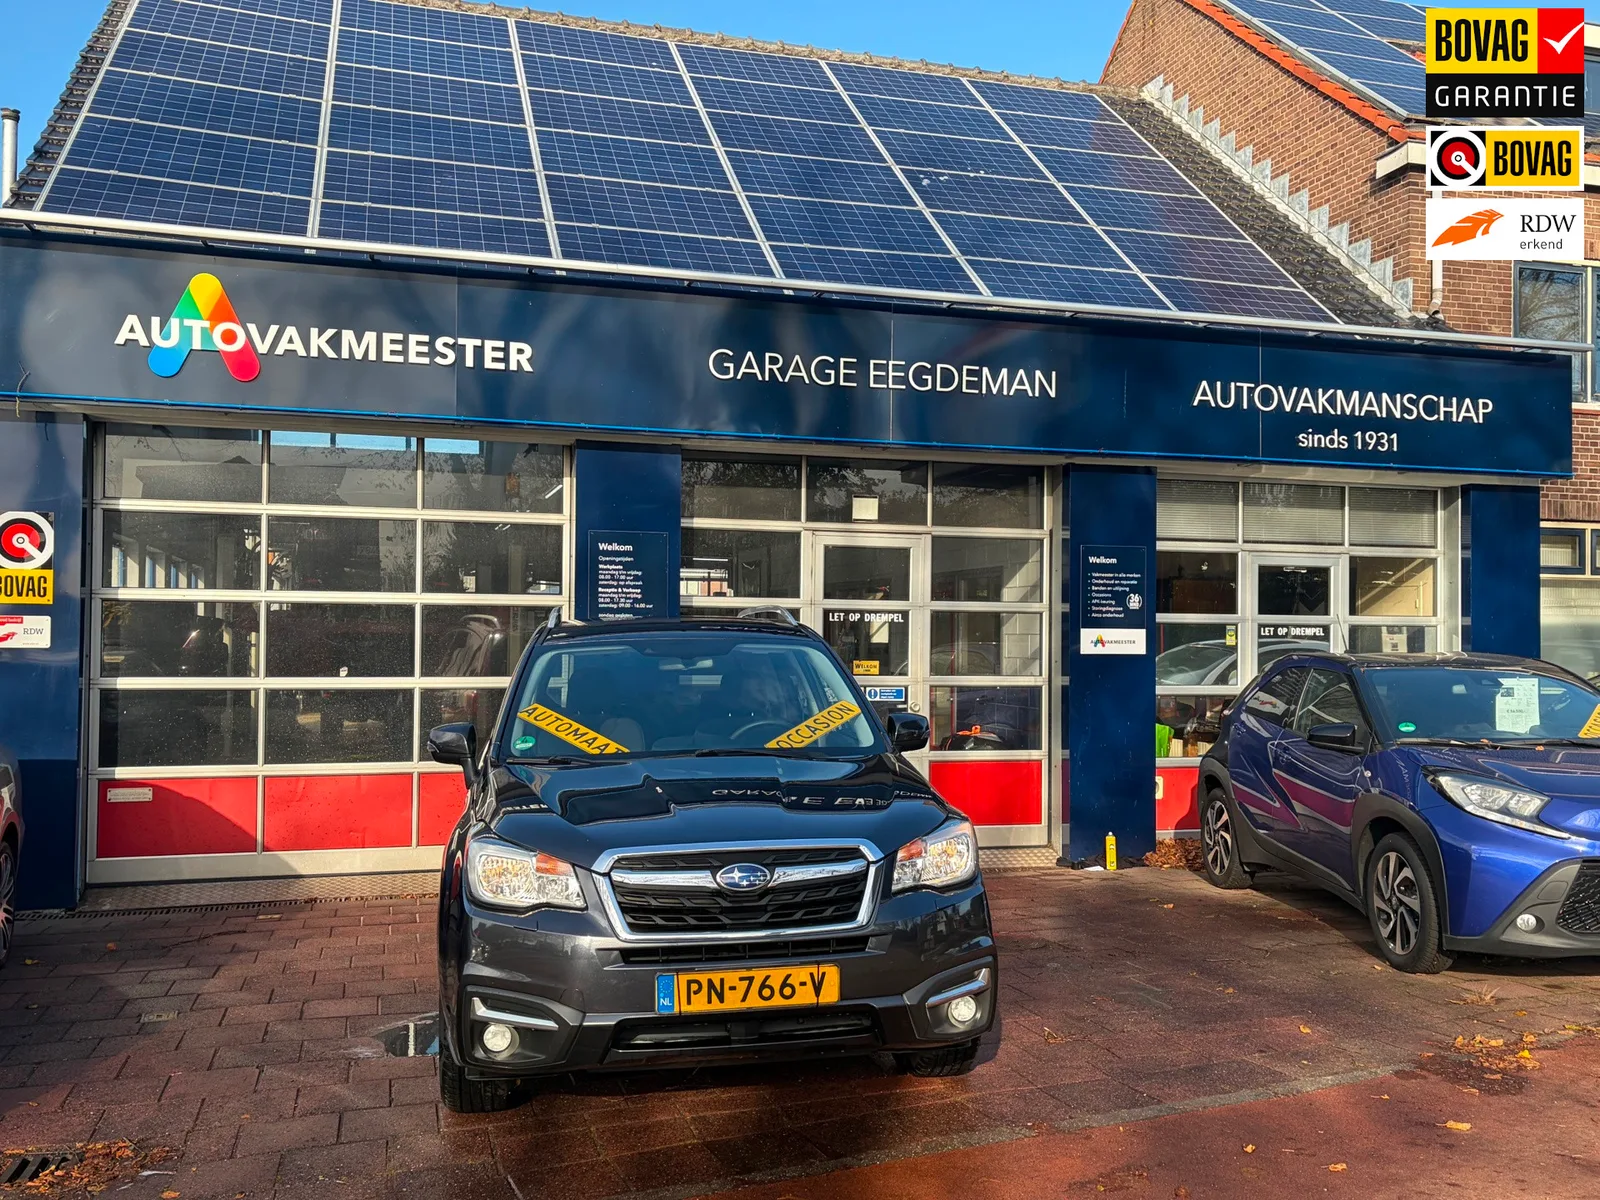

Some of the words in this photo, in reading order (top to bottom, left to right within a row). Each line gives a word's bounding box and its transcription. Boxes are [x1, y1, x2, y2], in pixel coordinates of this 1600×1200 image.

[114, 313, 535, 373] AUTOVAKMEESTER
[708, 348, 858, 387] GARAGE
[868, 359, 1057, 398] EEGDEMAN
[1193, 380, 1494, 424] AUTOVAKMANSCHAP
[1298, 429, 1349, 449] sinds
[1354, 431, 1398, 452] 1931
[598, 542, 633, 552] Welkom
[1088, 556, 1117, 564] Welkom
[0, 574, 48, 598] OVAG
[1129, 593, 1140, 602] 36
[829, 612, 845, 622] LET
[848, 612, 861, 622] OP
[864, 613, 904, 623] DREMPEL
[22, 627, 44, 635] RDW
[1260, 627, 1275, 636] LET
[1277, 627, 1288, 636] OP
[1290, 627, 1325, 636] DREMPEL
[775, 703, 856, 749] OCCASION
[686, 971, 827, 1006] PN-766-V
[660, 997, 673, 1007] NL
